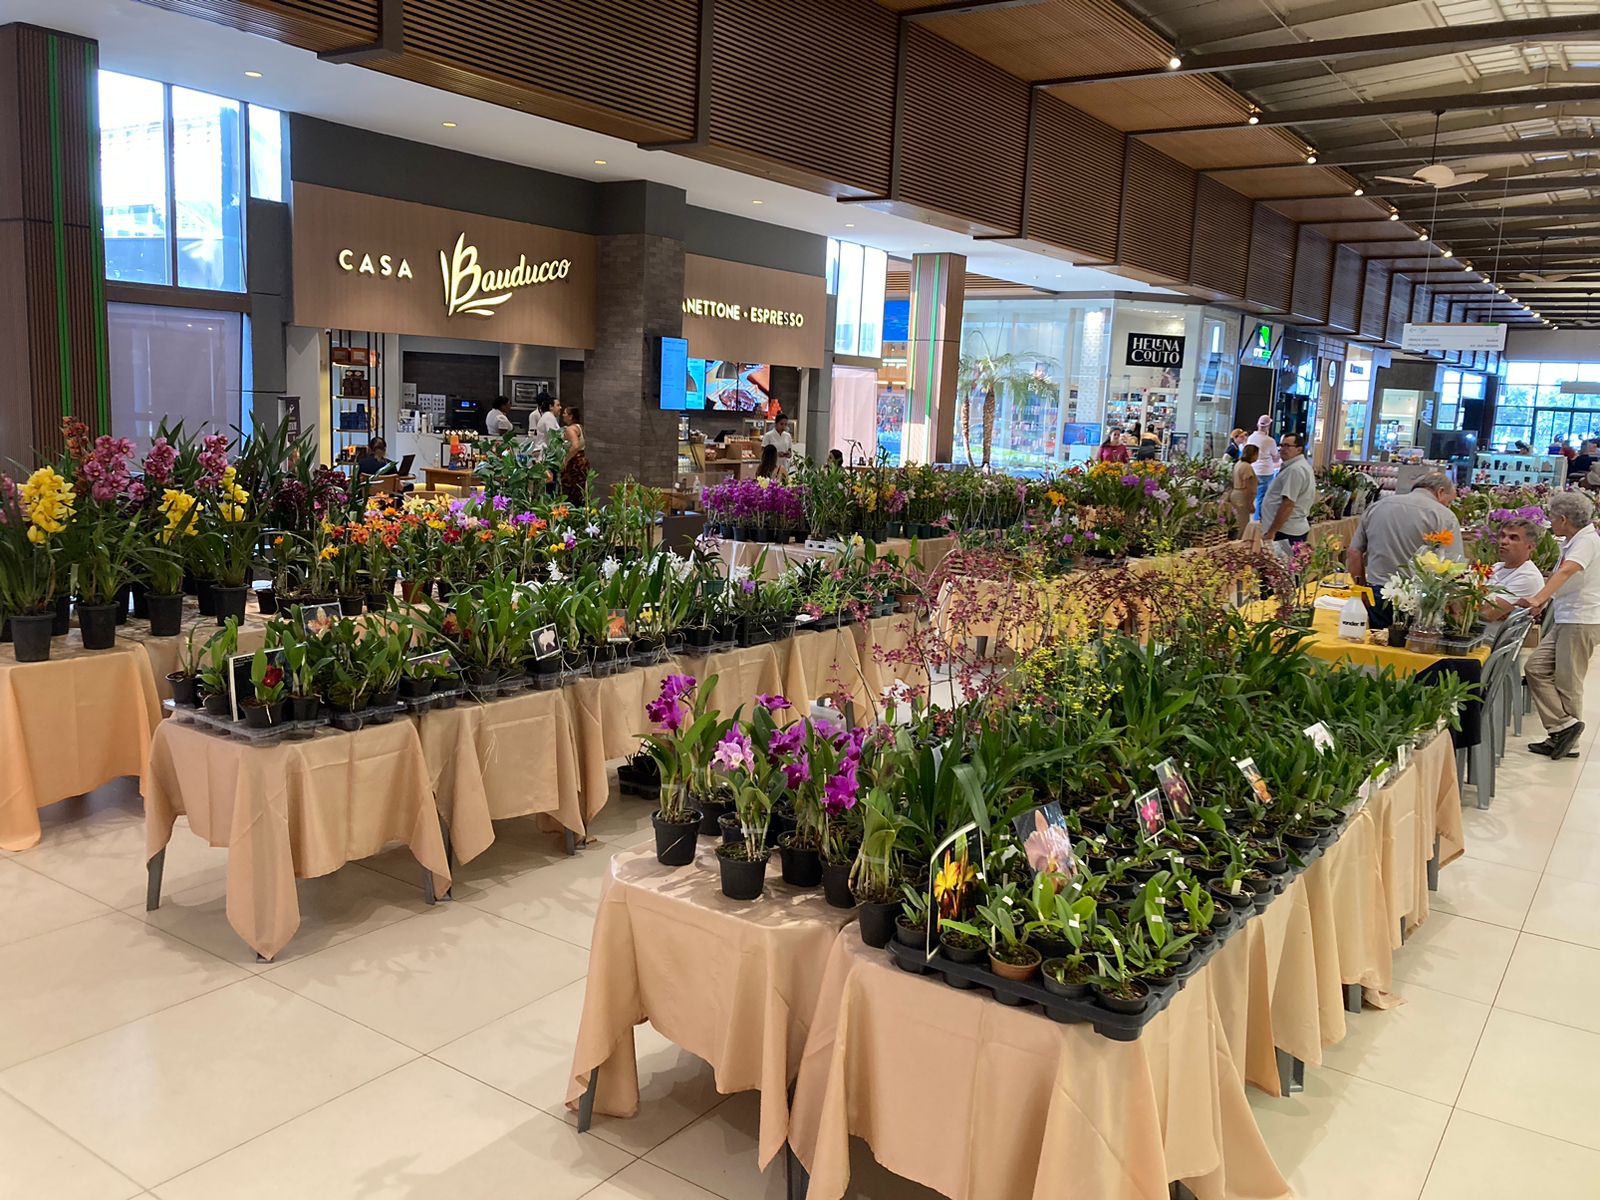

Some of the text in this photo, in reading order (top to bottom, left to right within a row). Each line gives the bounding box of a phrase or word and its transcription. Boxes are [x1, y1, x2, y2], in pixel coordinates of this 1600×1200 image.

[338, 232, 572, 317] CASA Bauducco
[750, 306, 804, 328] ESPRESSO
[1132, 337, 1180, 352] HELENA
[1131, 349, 1180, 364] COUTO
